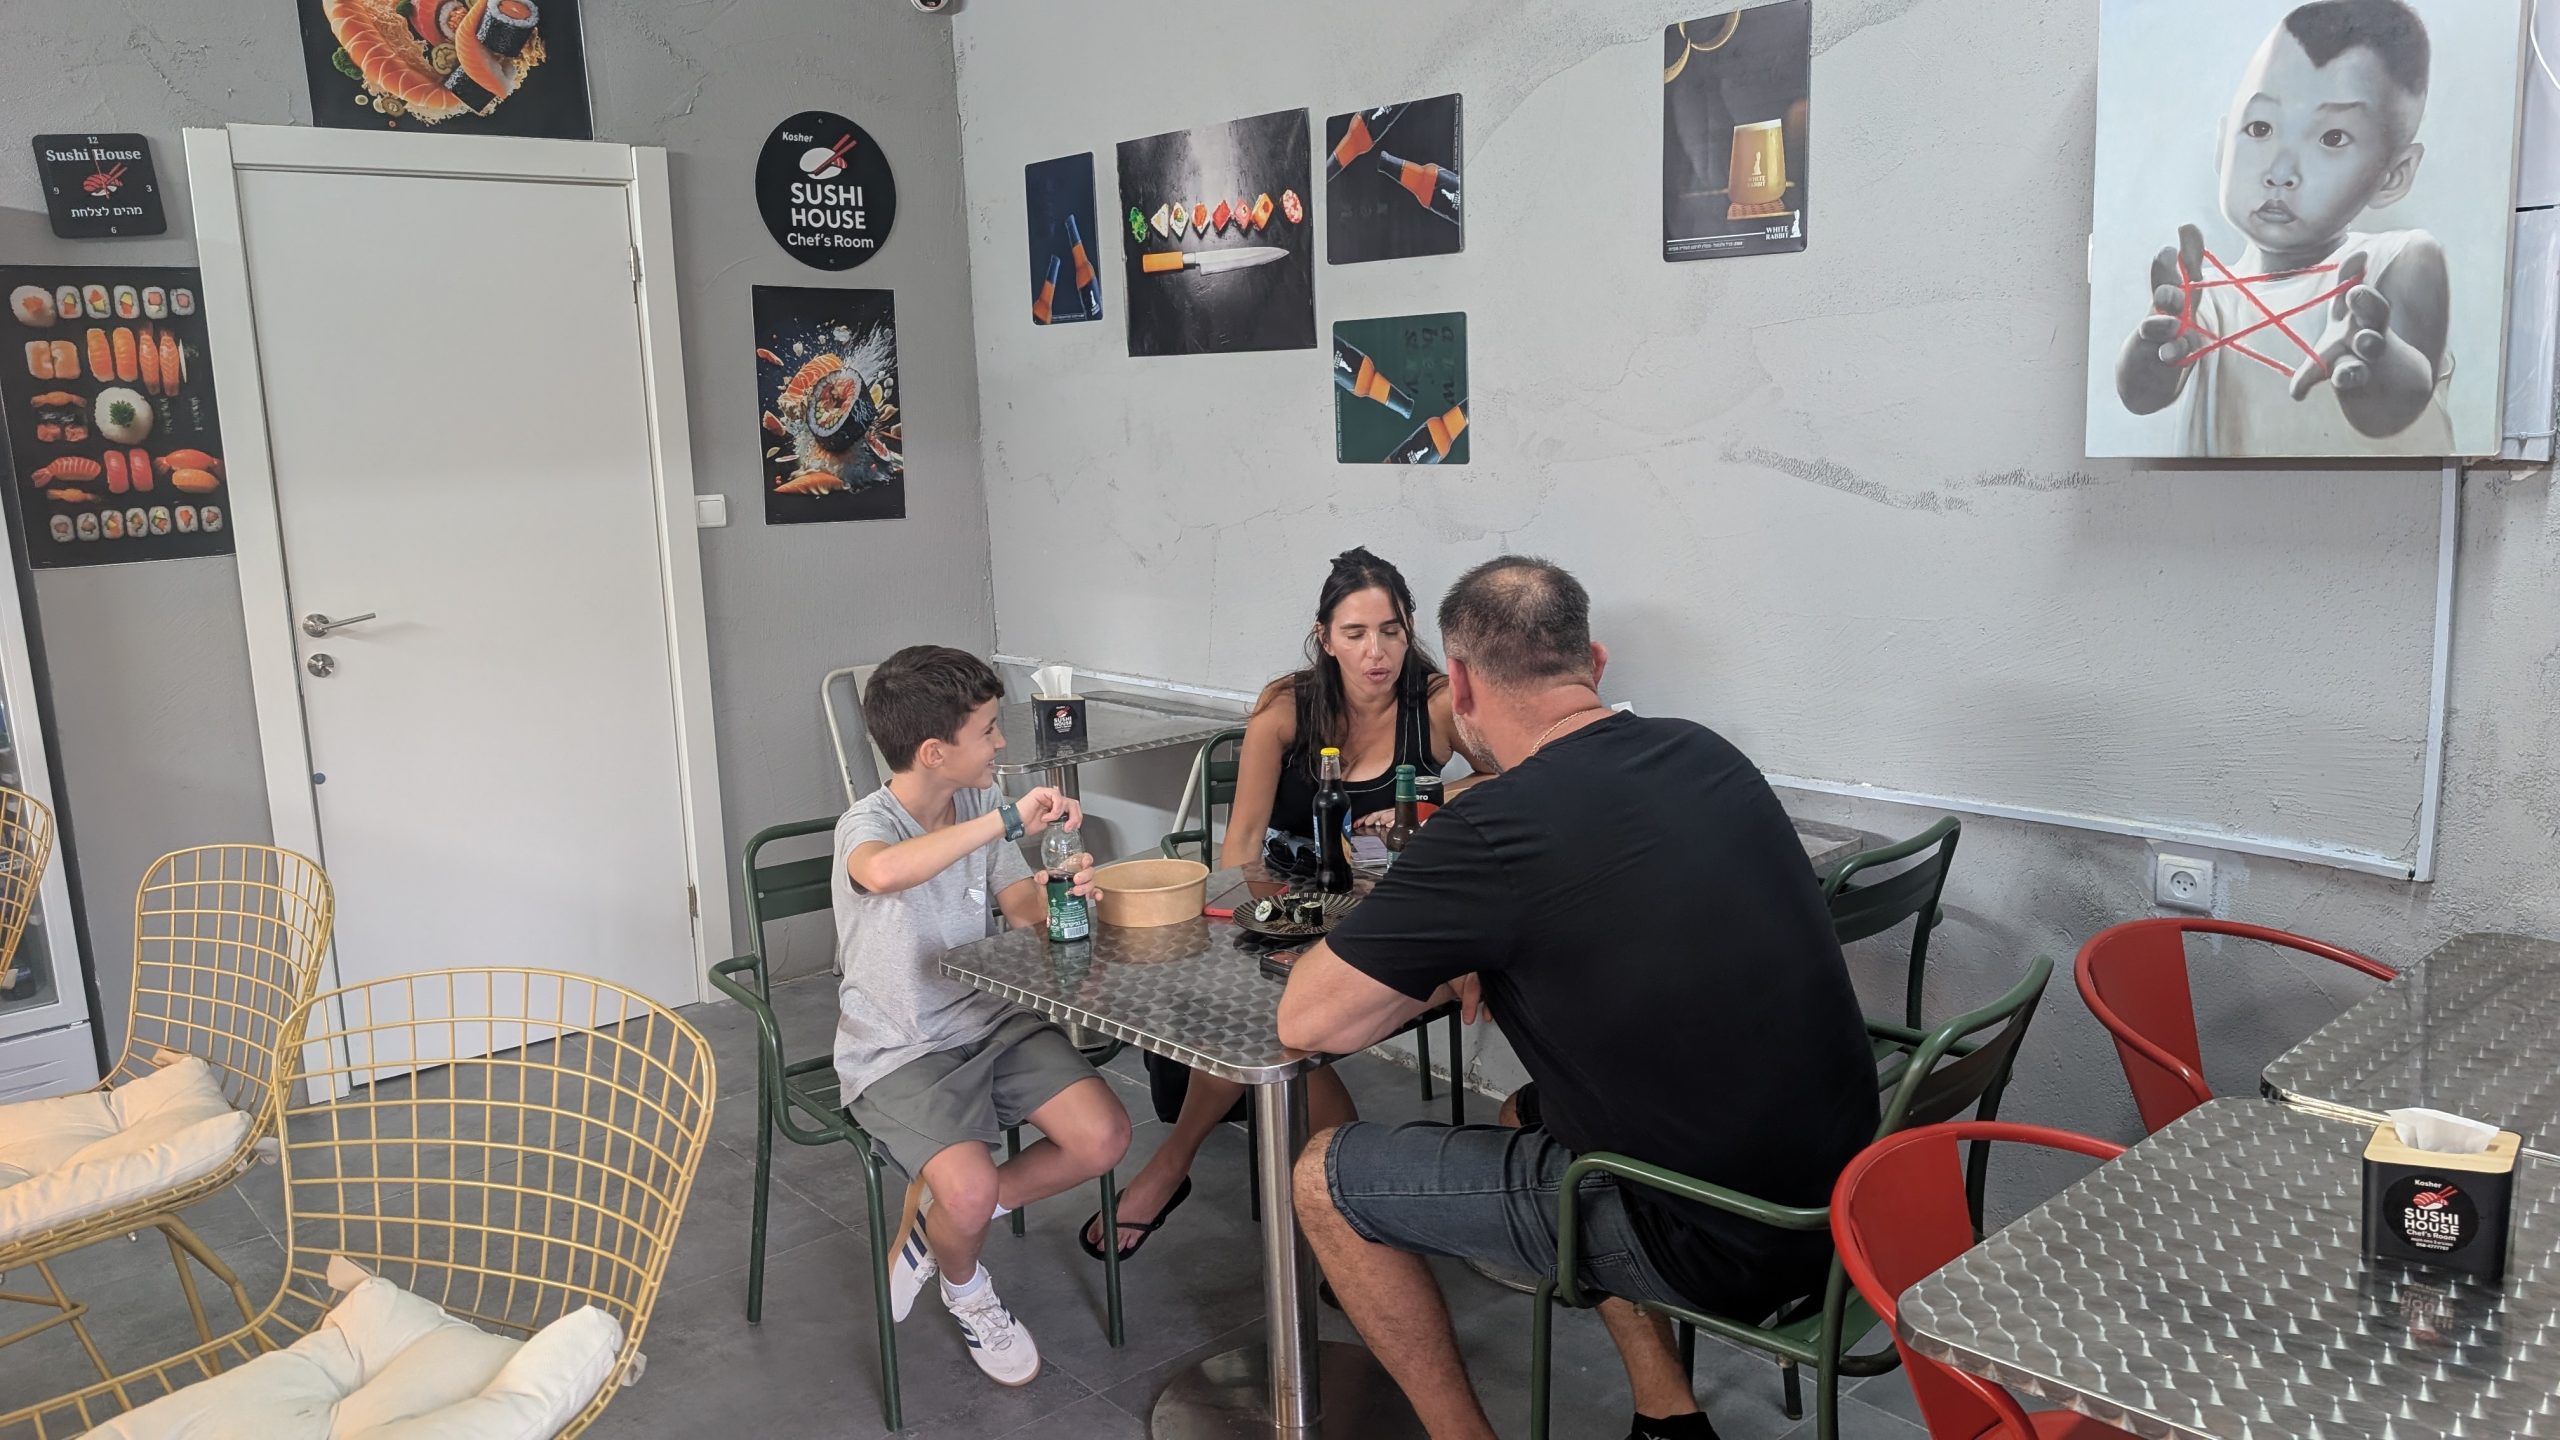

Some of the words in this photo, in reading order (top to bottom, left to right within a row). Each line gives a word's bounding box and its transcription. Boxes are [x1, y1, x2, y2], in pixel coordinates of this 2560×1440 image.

[87, 136, 99, 144] 12
[782, 131, 814, 143] Kosher
[46, 148, 90, 161] Sushi
[92, 149, 142, 161] House
[53, 186, 60, 195] 9
[145, 184, 153, 192] 3
[790, 182, 864, 207] SUSHI
[71, 206, 110, 218] לצלחת
[113, 205, 143, 217] מהים
[791, 207, 867, 230] HOUSE
[110, 226, 117, 234] 6
[1765, 225, 1789, 234] WHITE
[787, 232, 832, 247] Chef's
[834, 234, 874, 248] Room
[1765, 232, 1789, 241] RABBIT
[2414, 1179, 2442, 1189] Kosher
[2404, 1207, 2459, 1225] SUSHI
[2404, 1218, 2460, 1236] HOUSE
[2406, 1229, 2432, 1238] Chef's
[2432, 1232, 2457, 1242] Room
